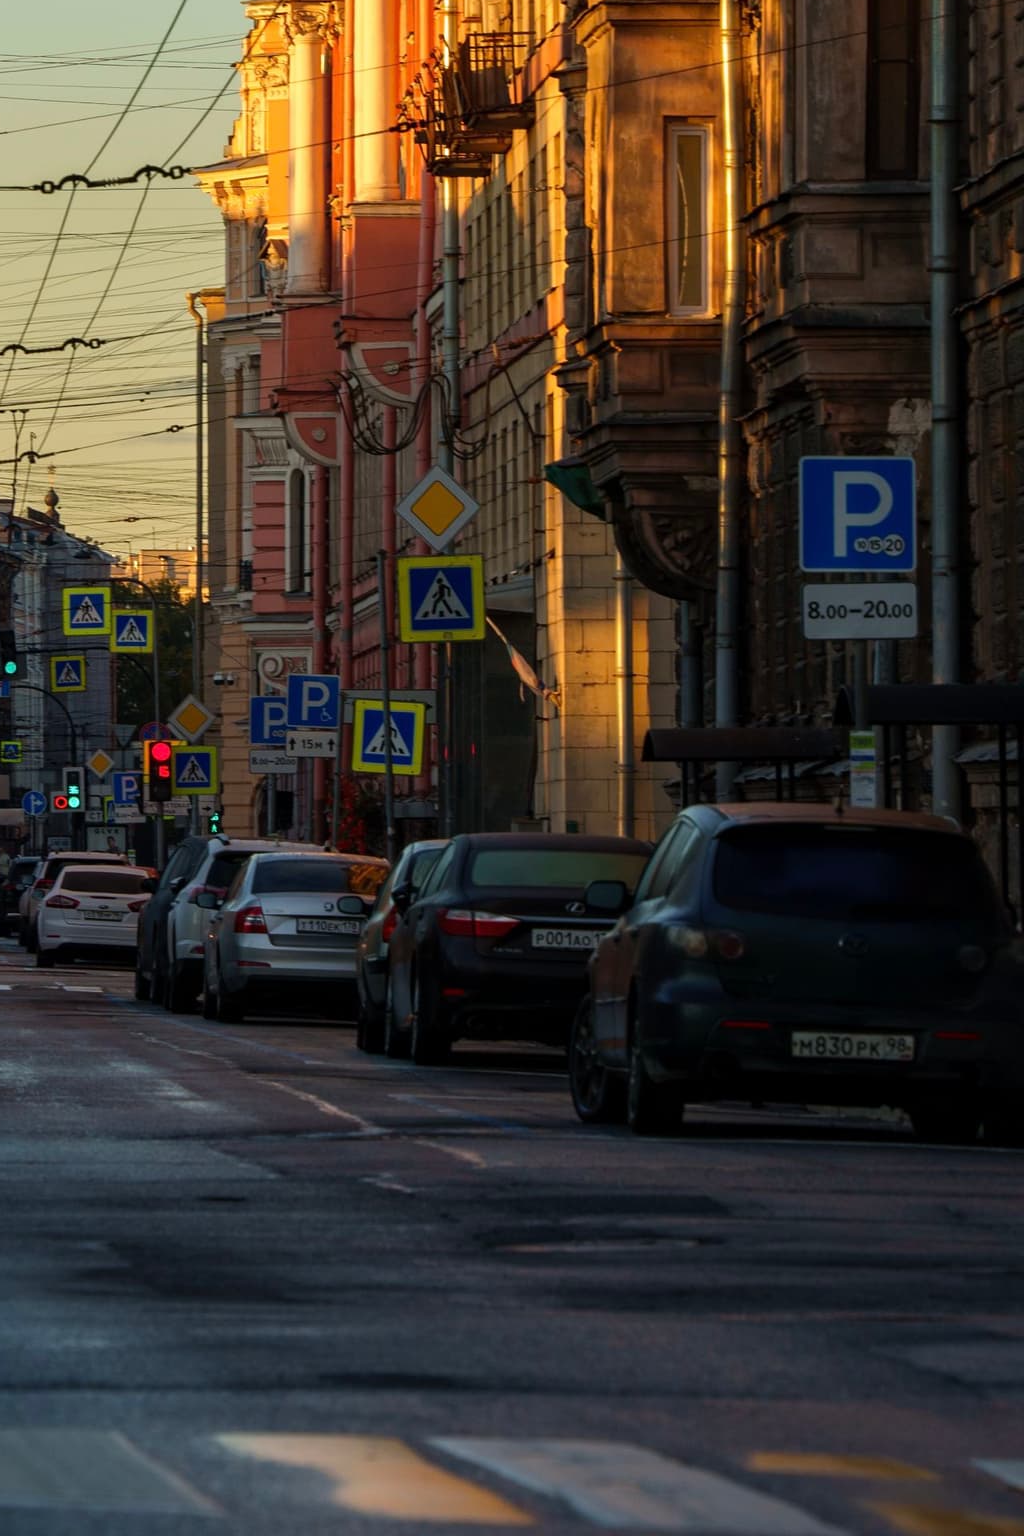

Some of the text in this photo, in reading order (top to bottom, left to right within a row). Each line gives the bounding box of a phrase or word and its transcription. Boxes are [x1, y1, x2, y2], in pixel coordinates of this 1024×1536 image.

[833, 471, 893, 557] P
[870, 540, 881, 550] 15
[885, 538, 903, 551] 20
[301, 680, 330, 721] P
[263, 702, 287, 740] P
[301, 739, 314, 749] 15
[121, 775, 138, 801] P
[886, 1037, 906, 1052] 98
